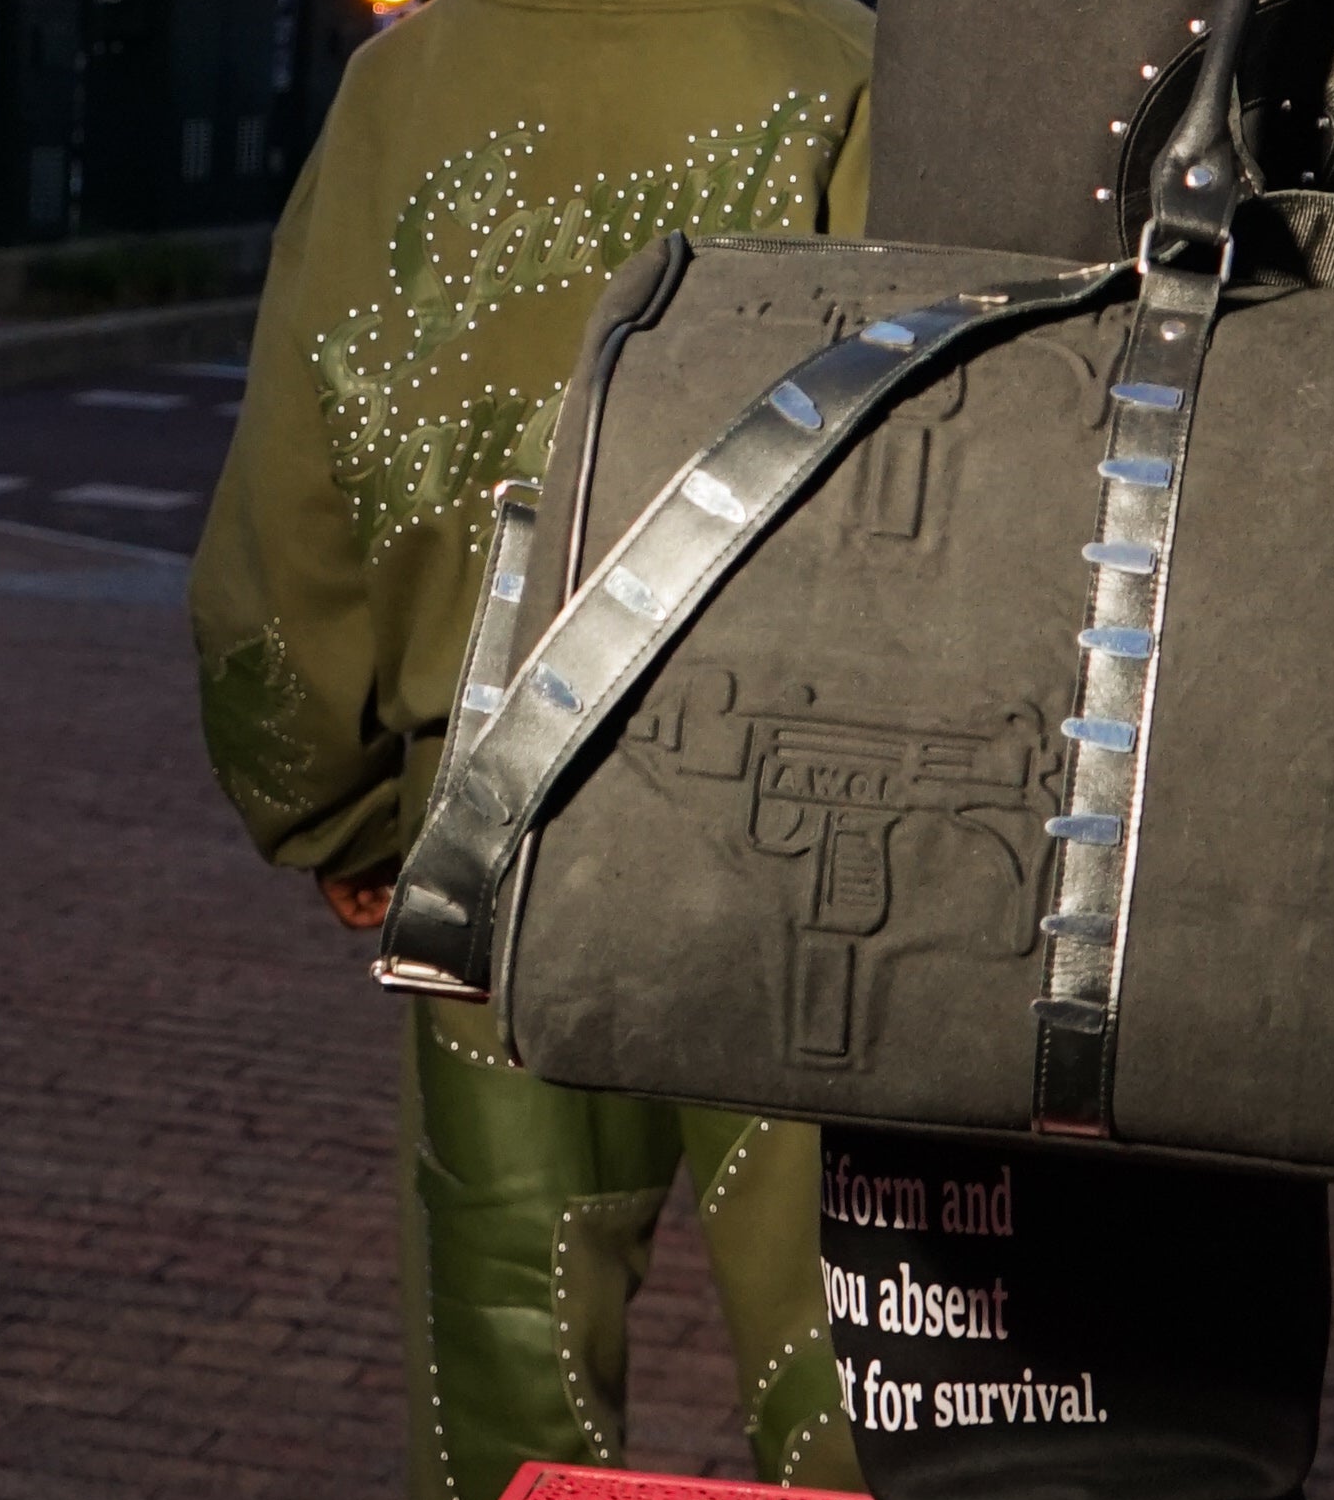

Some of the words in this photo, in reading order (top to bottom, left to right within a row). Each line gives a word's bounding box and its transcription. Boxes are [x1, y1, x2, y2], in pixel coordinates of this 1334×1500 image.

[942, 1165, 1014, 1237] and
[878, 1262, 1009, 1340] absent
[864, 1359, 923, 1432] for
[933, 1367, 1108, 1428] survival.
